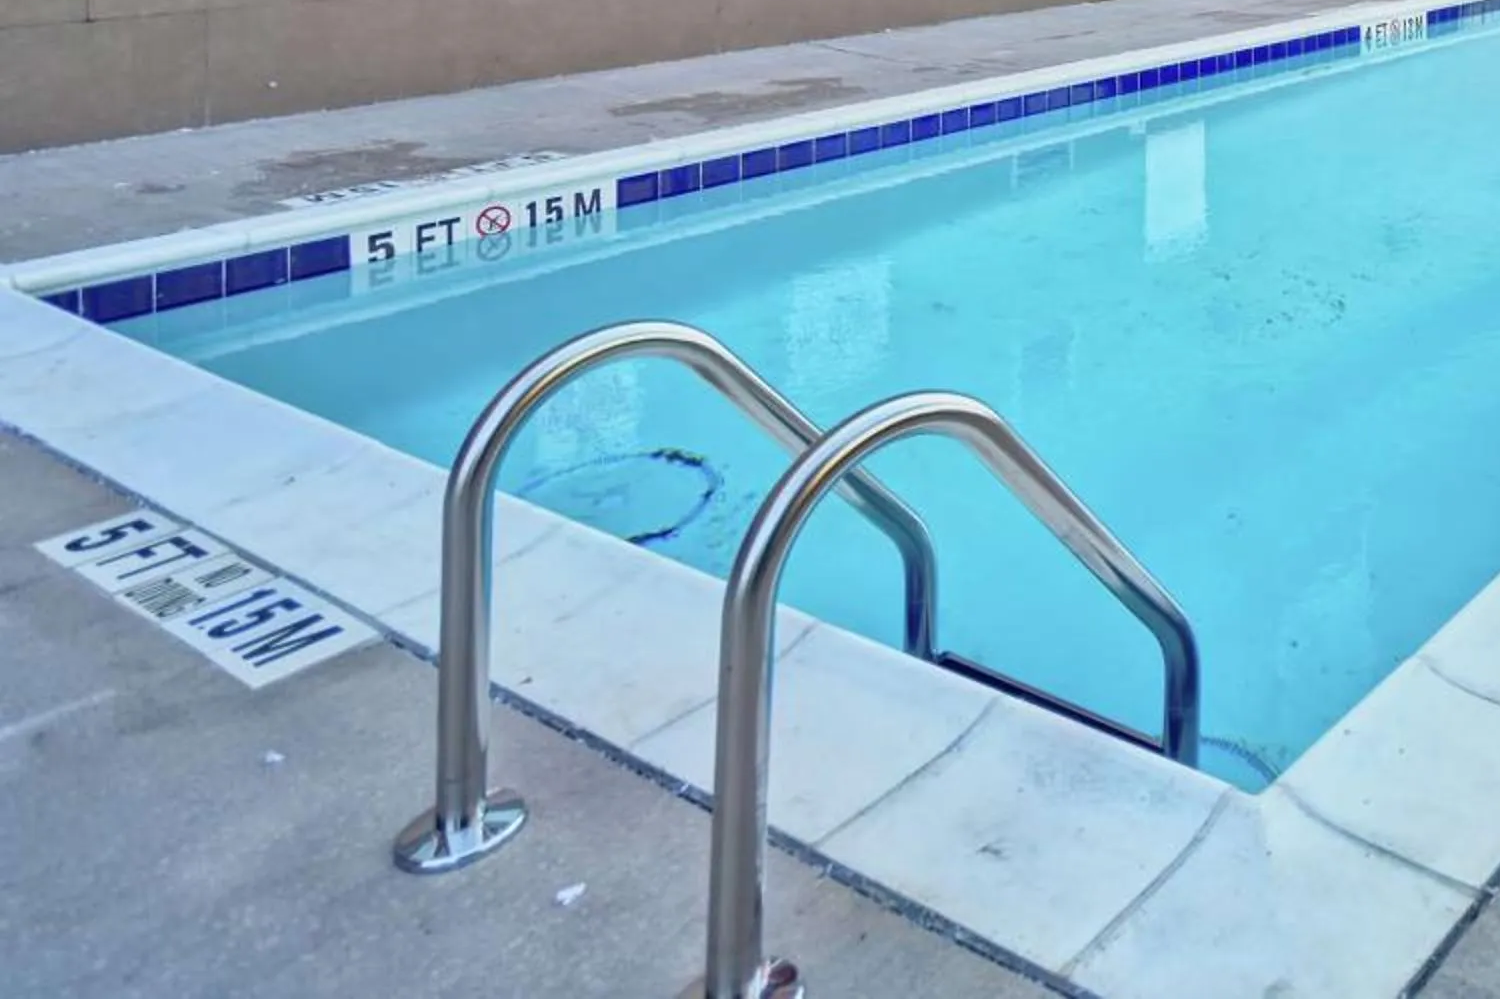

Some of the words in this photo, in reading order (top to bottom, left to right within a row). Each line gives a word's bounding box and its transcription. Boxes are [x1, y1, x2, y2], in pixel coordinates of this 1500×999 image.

[367, 230, 396, 263] 5
[415, 216, 462, 253] FT
[64, 518, 155, 552] 5
[95, 535, 209, 580] FT
